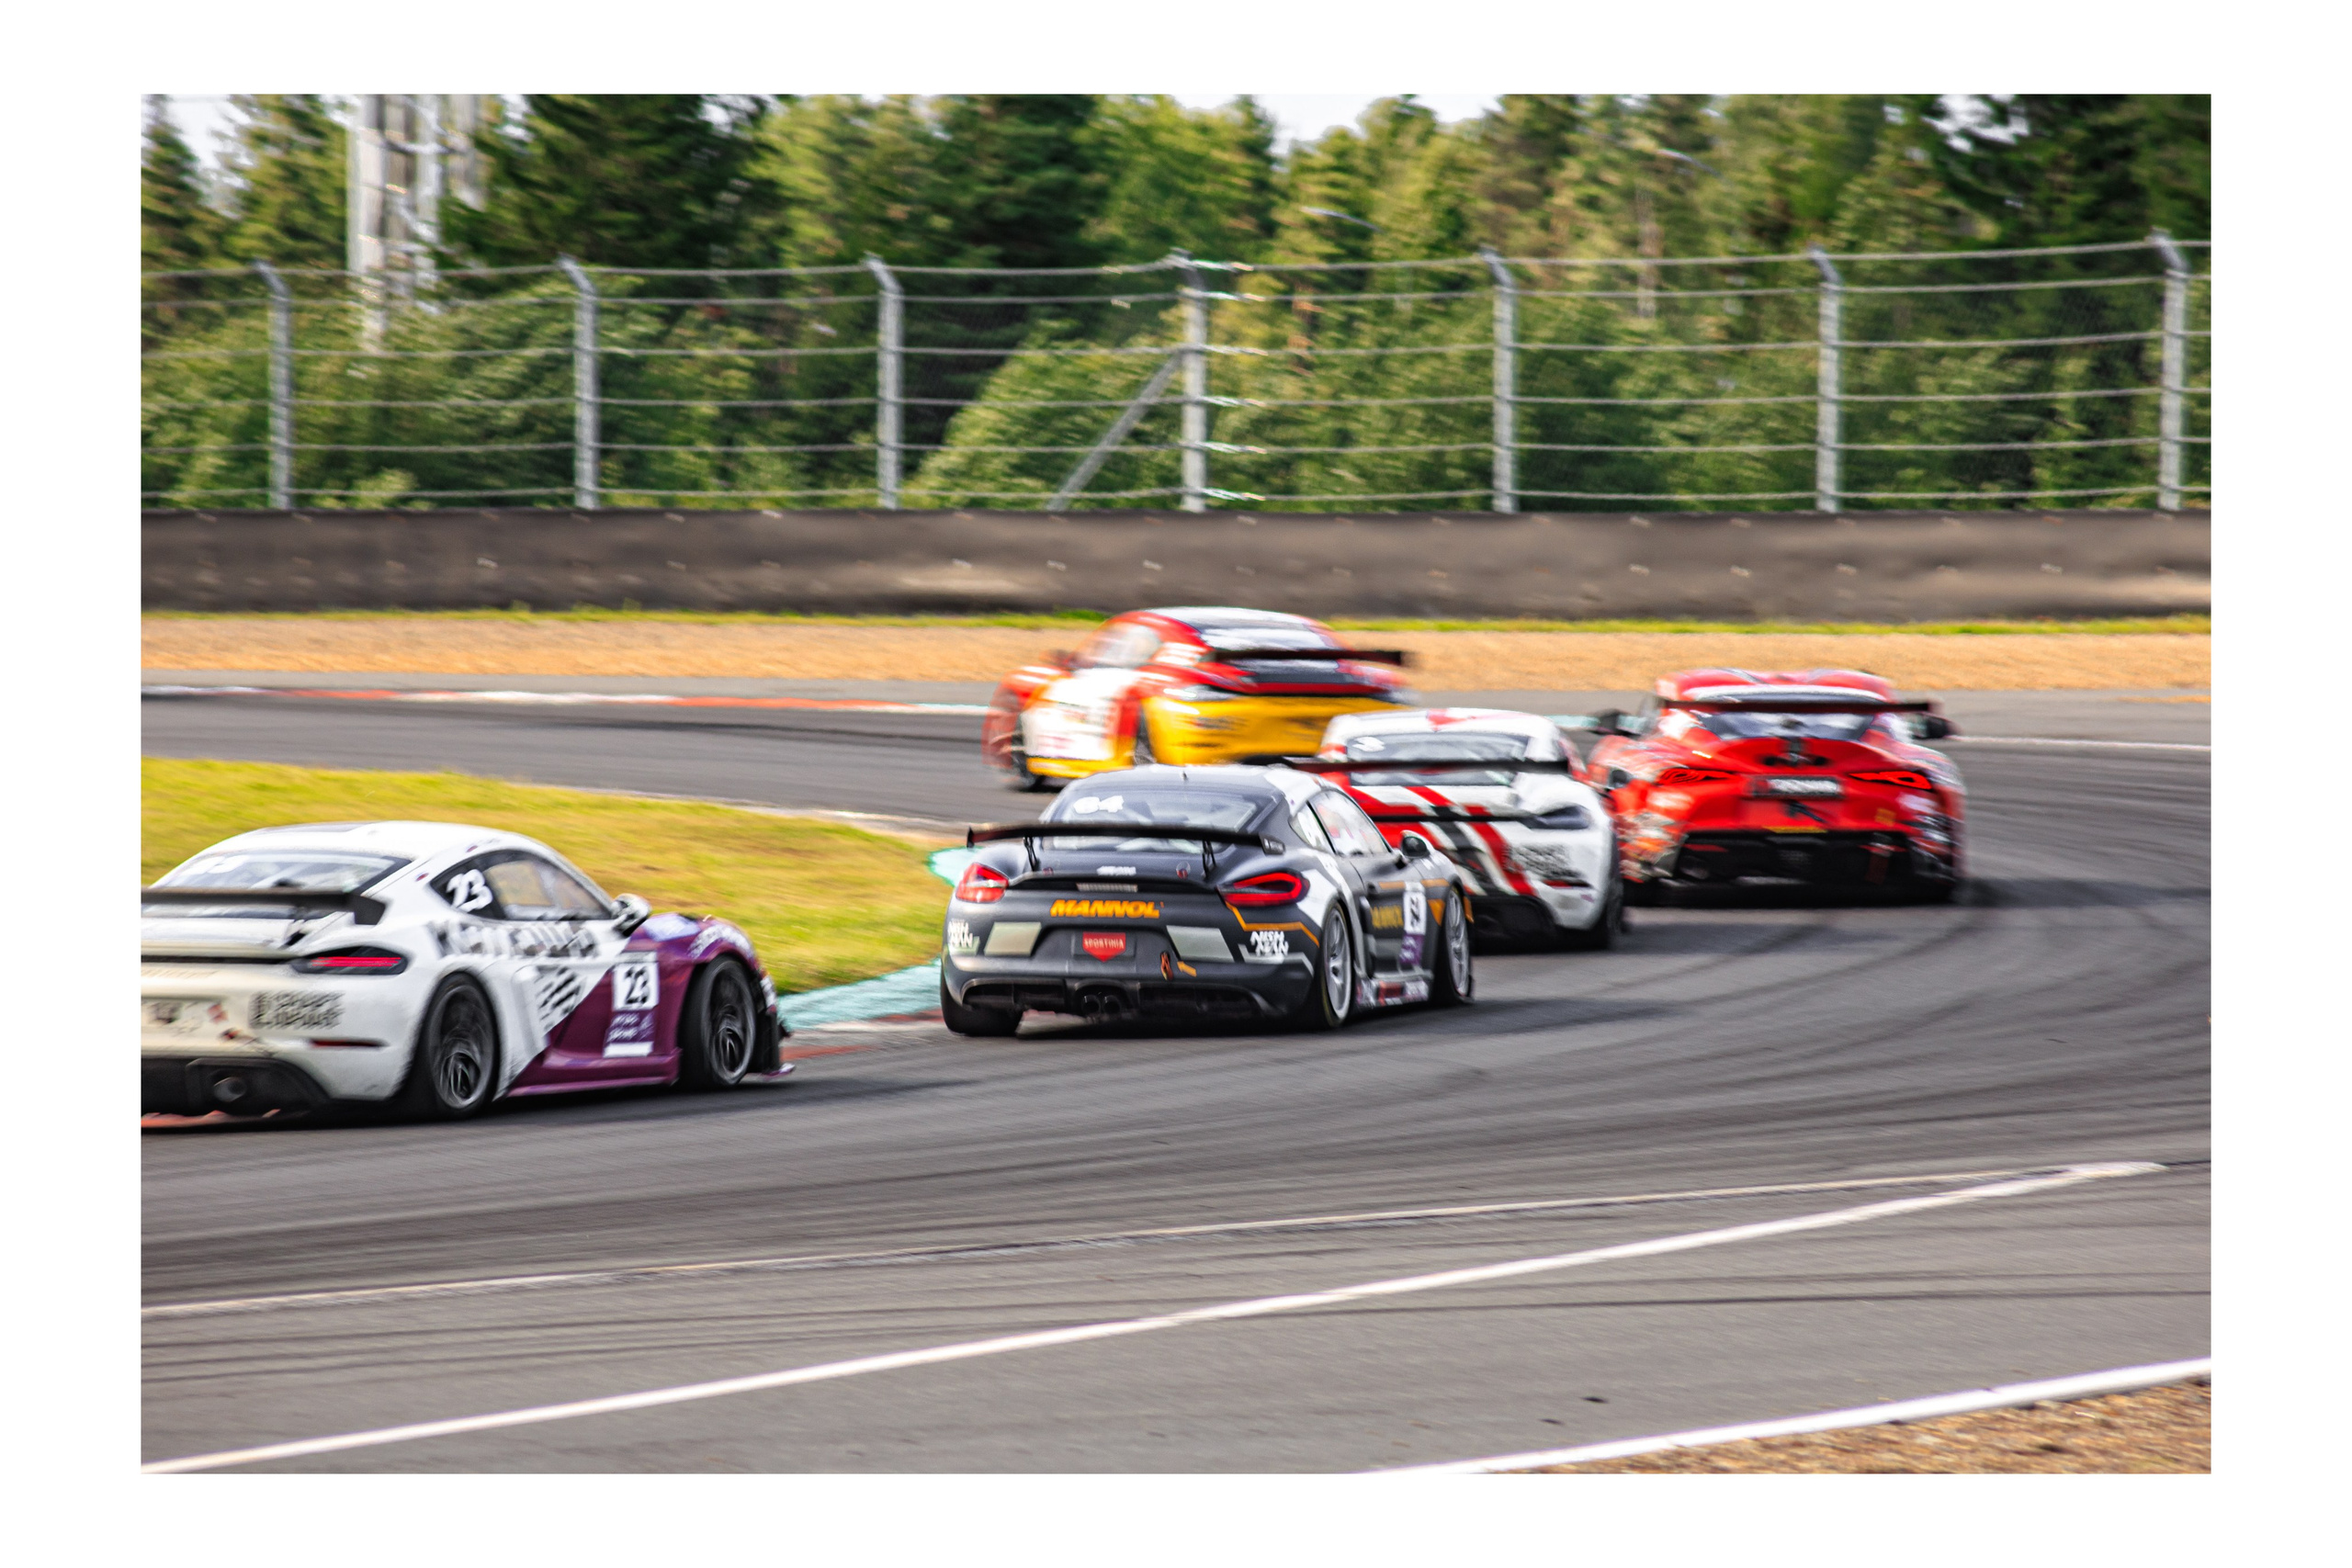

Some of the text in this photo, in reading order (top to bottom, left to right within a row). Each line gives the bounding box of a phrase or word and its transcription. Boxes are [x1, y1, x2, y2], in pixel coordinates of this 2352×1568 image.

[447, 869, 492, 912] 23
[1050, 899, 1159, 919] MANNOL
[1084, 938, 1124, 949] SPORTINIA
[1250, 931, 1284, 945] NISH
[625, 966, 650, 1005] 23
